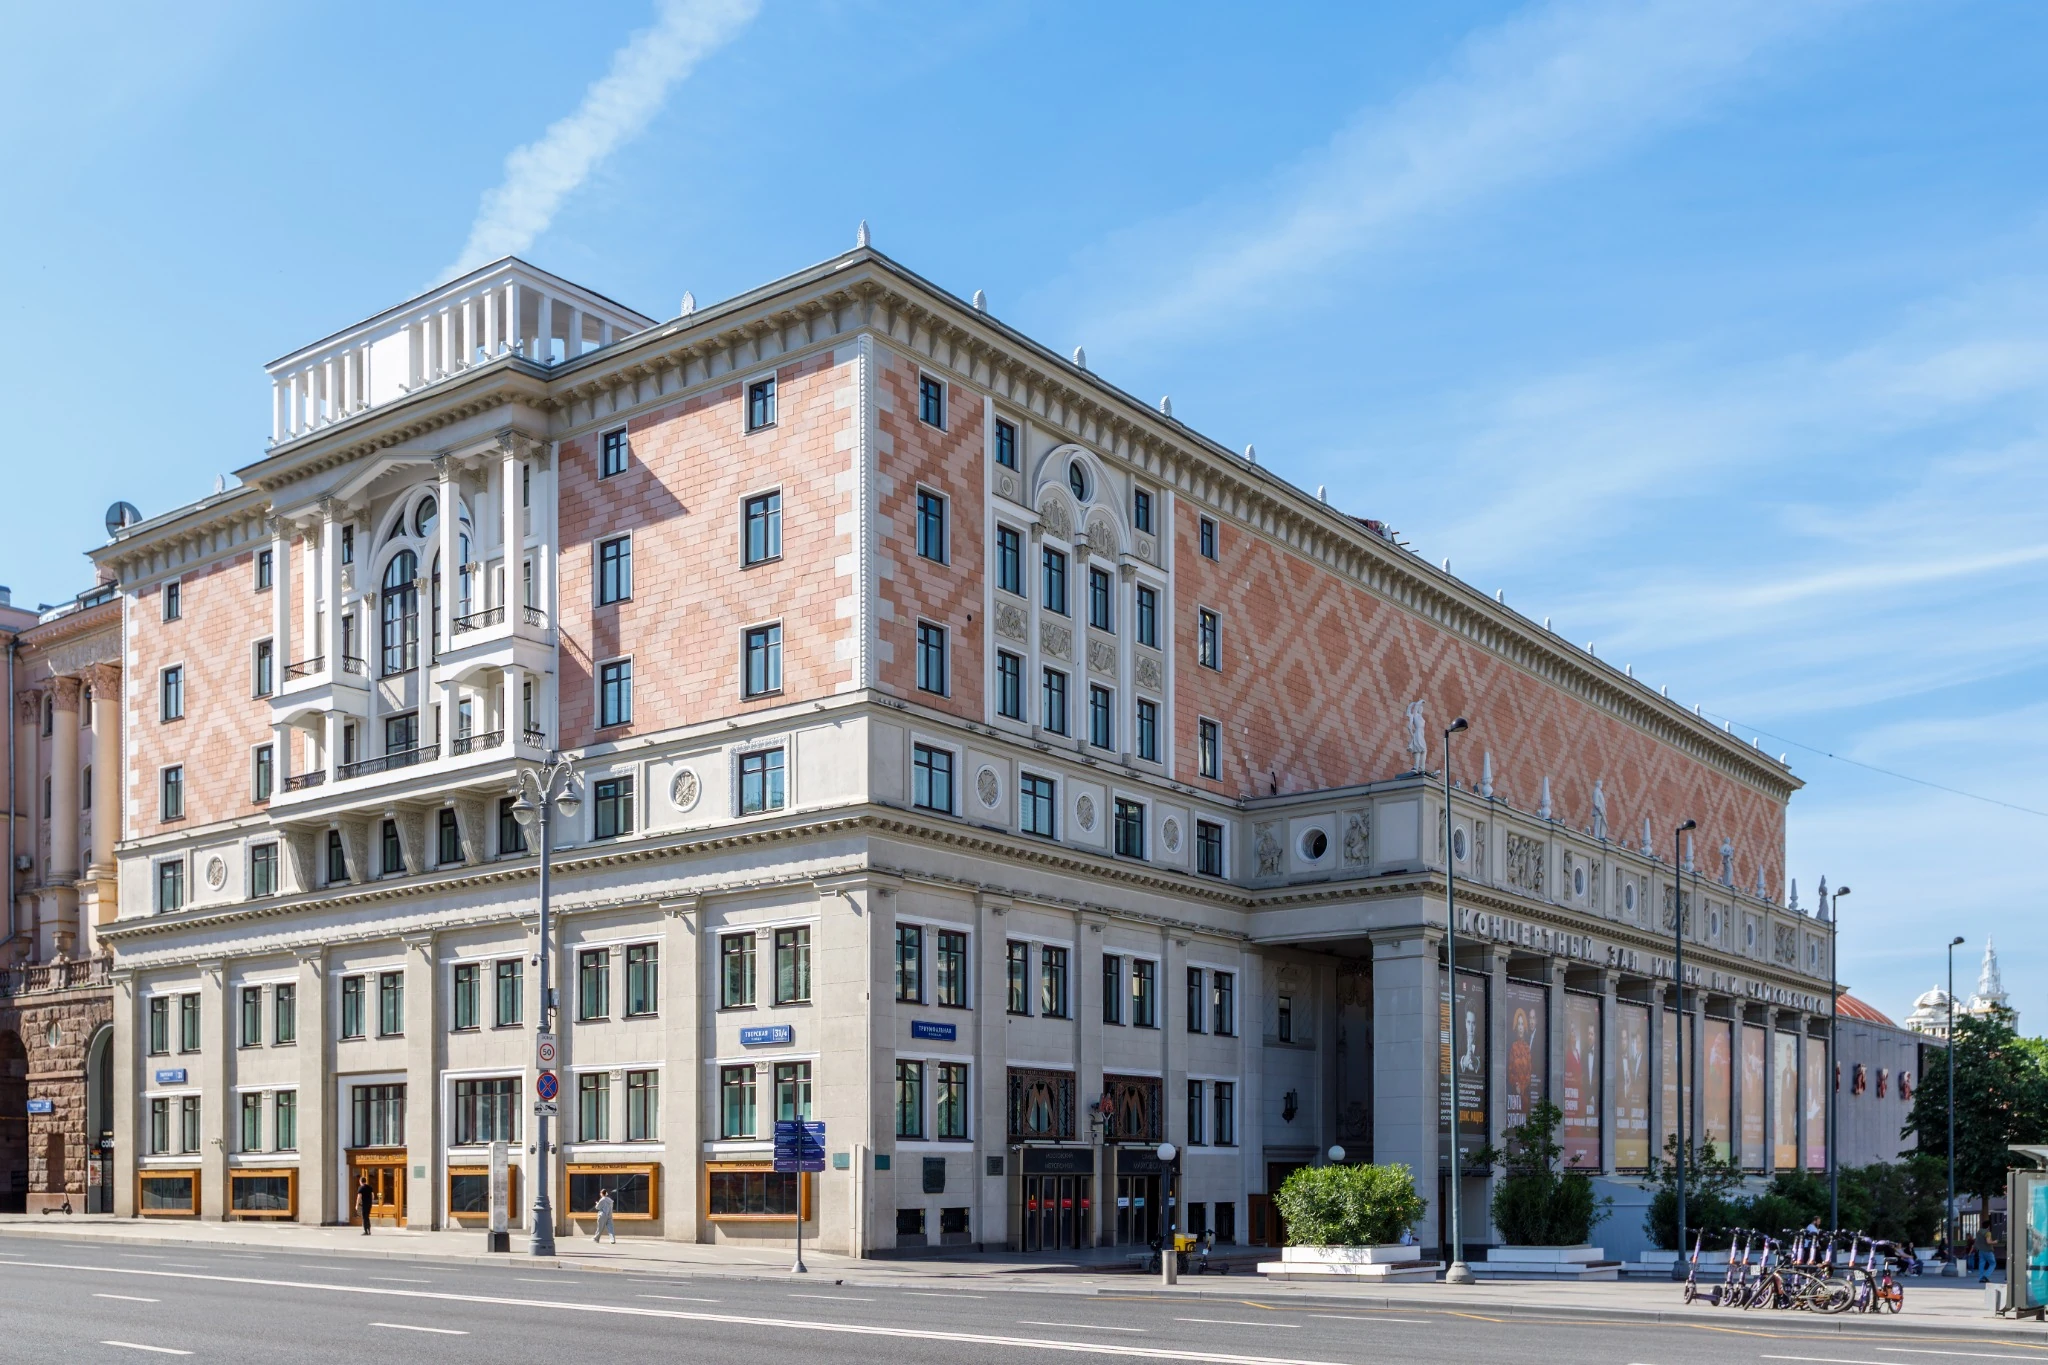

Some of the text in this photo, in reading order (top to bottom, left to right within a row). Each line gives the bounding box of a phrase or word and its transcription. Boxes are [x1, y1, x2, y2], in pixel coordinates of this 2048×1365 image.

[1459, 908, 1594, 960] КОНЦЕРТНЫЙ
[1607, 946, 1638, 970] ЗАЛ
[1652, 957, 1701, 984] ИМНИ
[1746, 981, 1825, 1013] ЧАЙКОВСКОГО
[774, 1029, 788, 1037] 31/4
[542, 1048, 552, 1056] 50
